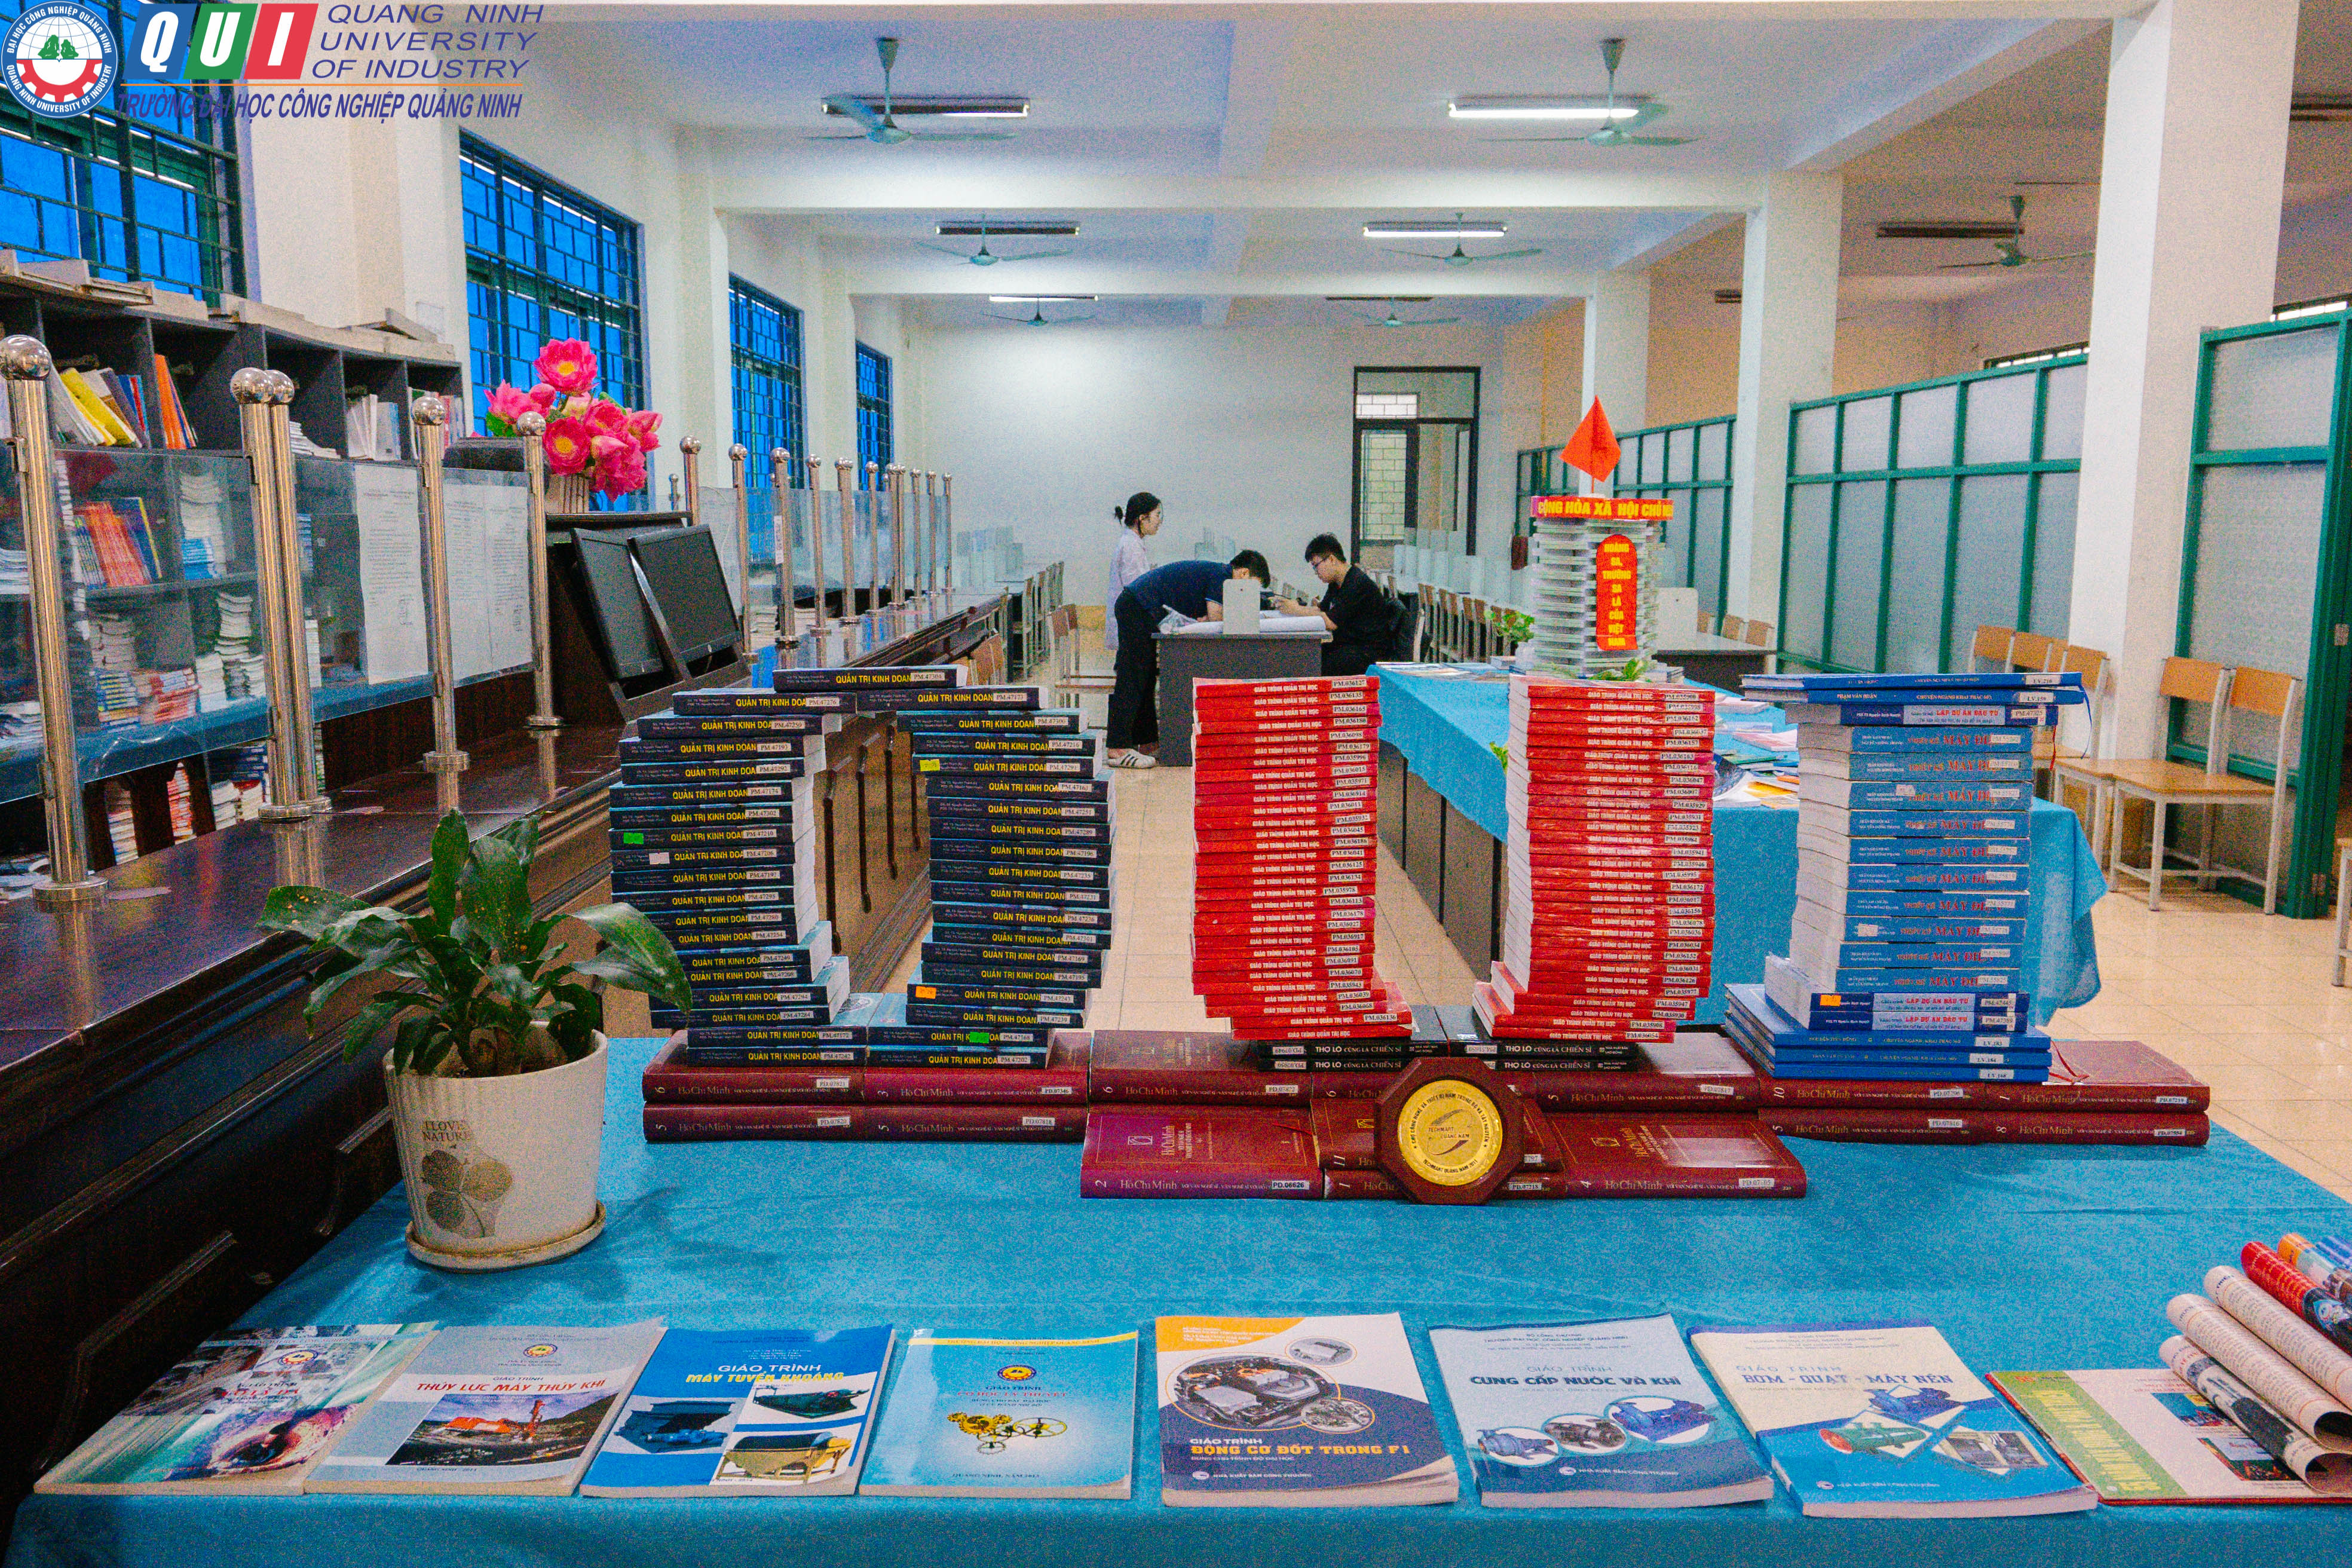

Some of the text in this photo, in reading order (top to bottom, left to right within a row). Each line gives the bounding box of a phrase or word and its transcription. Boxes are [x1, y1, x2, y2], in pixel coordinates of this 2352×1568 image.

[1538, 499, 1563, 516] CỘNG
[1594, 501, 1612, 516] XÃ
[1618, 501, 1639, 518] HỘI
[941, 694, 952, 703] TRỊ
[759, 699, 770, 708] TRỊ
[696, 874, 707, 882] TRỊ
[770, 1053, 782, 1061] TRỊ
[1527, 1364, 1563, 1373] GIÁO
[685, 1373, 722, 1383] MÁY
[780, 1372, 844, 1382] KHOÁNG
[1471, 1376, 1519, 1385] CUNG
[580, 1377, 607, 1389] KHÍ
[1190, 1443, 1410, 1456] ĐỘNG CƠ ĐỐT TRONG F1
